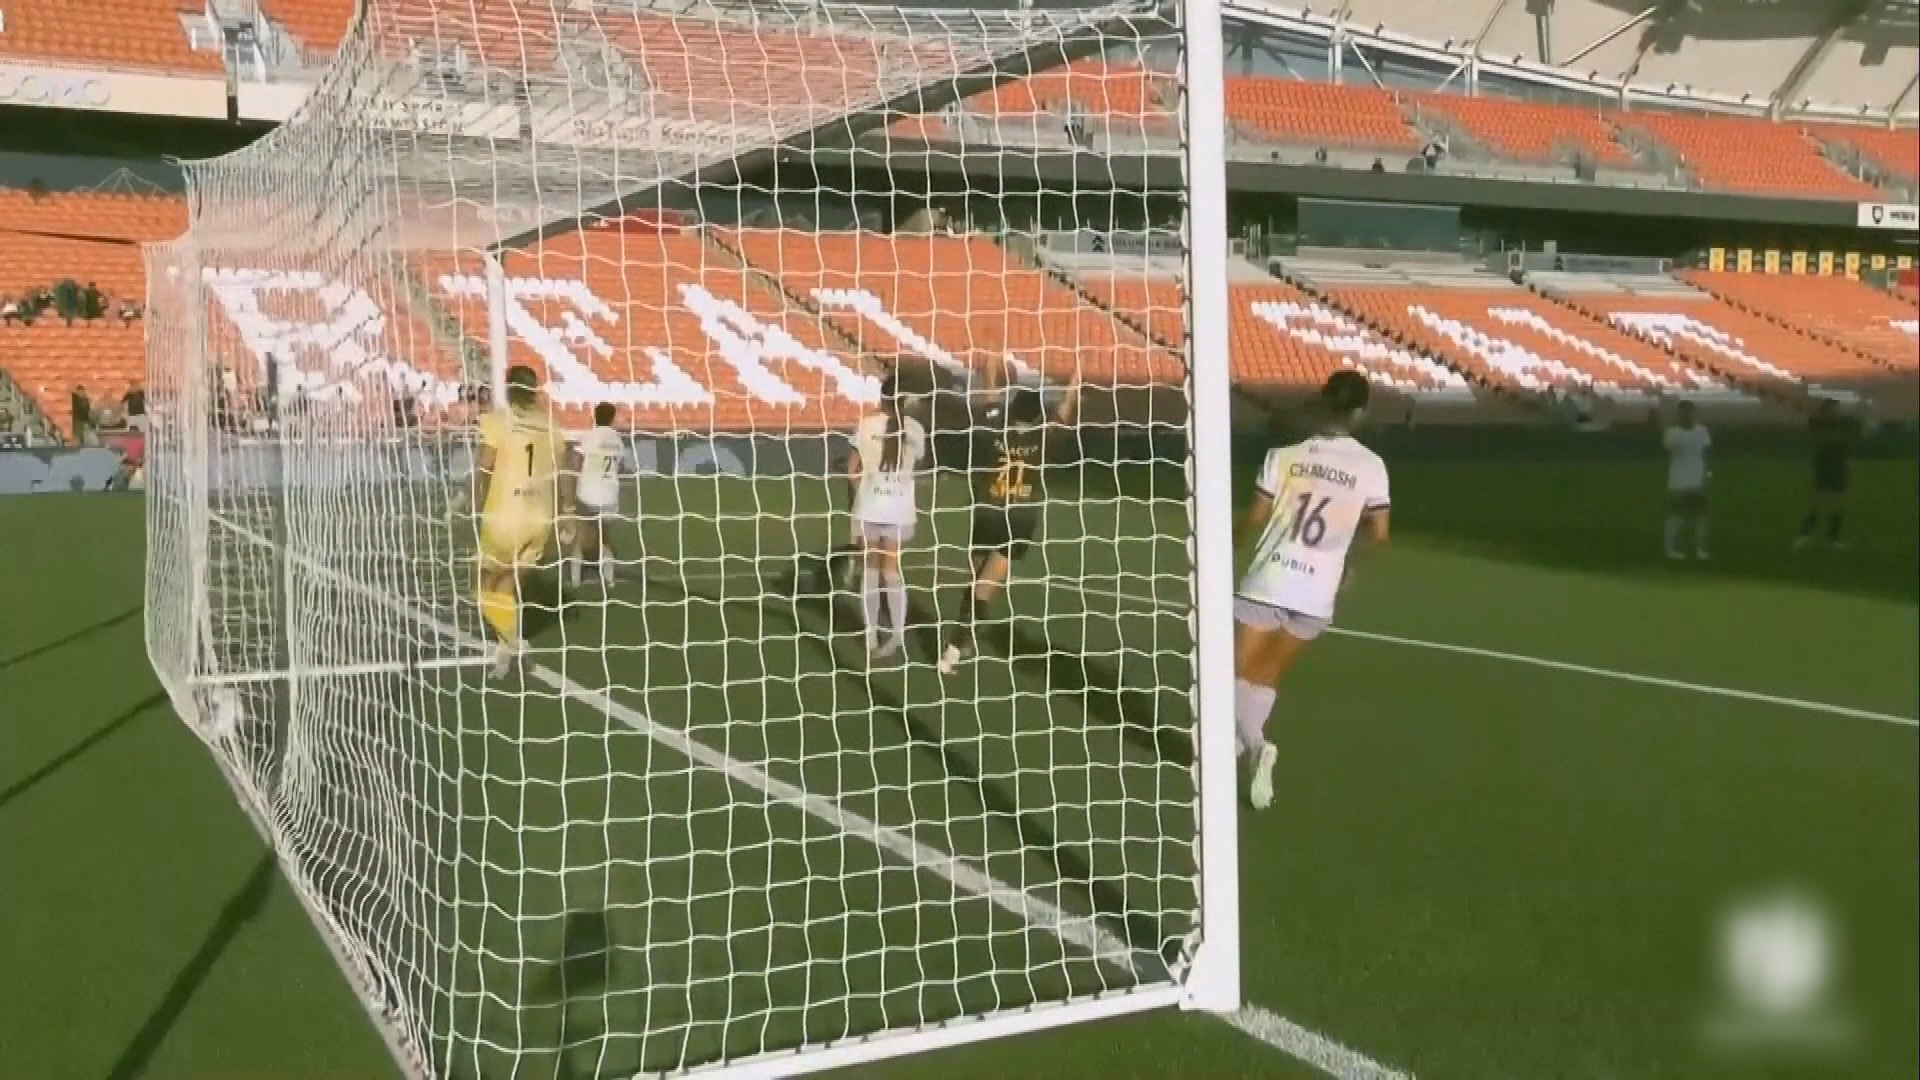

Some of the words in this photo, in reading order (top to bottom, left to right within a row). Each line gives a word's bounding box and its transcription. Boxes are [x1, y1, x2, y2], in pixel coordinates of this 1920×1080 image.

[525, 443, 534, 478] 1
[1288, 462, 1358, 492] CHAVOSHI
[1288, 491, 1332, 549] 16
